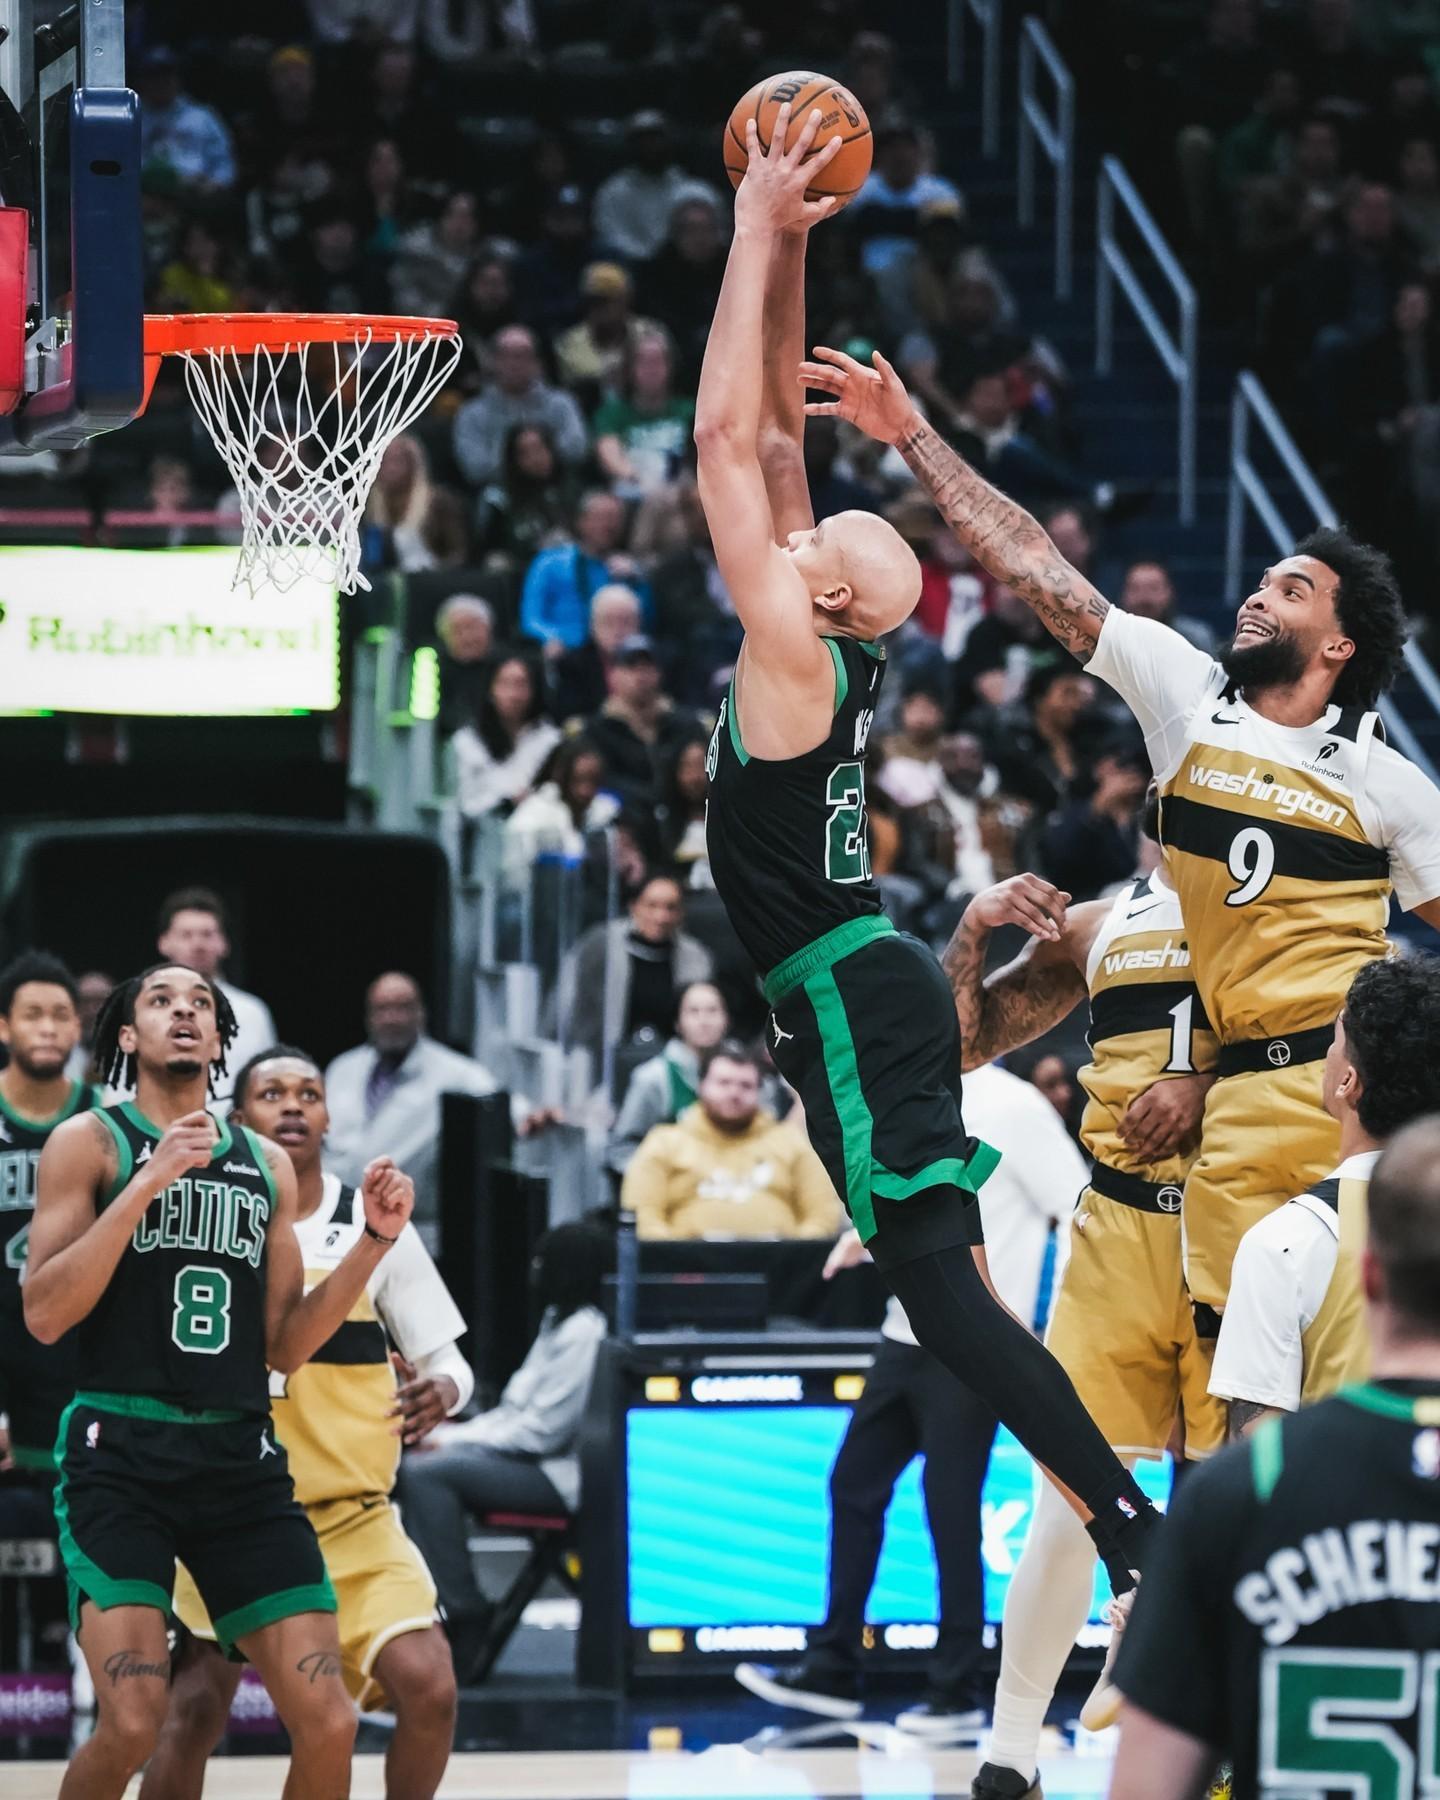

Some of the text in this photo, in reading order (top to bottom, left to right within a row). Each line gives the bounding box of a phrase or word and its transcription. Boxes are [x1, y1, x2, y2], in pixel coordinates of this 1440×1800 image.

[1190, 765, 1348, 827] washington
[1301, 760, 1344, 781] Robinhood
[825, 761, 873, 883] 2
[1224, 826, 1275, 907] 9
[1161, 993, 1199, 1073] 1
[132, 1178, 269, 1268] CELTICS
[171, 1265, 231, 1354] 8
[1234, 1518, 1440, 1646] SCHEIE
[1258, 1645, 1440, 1800] 5
